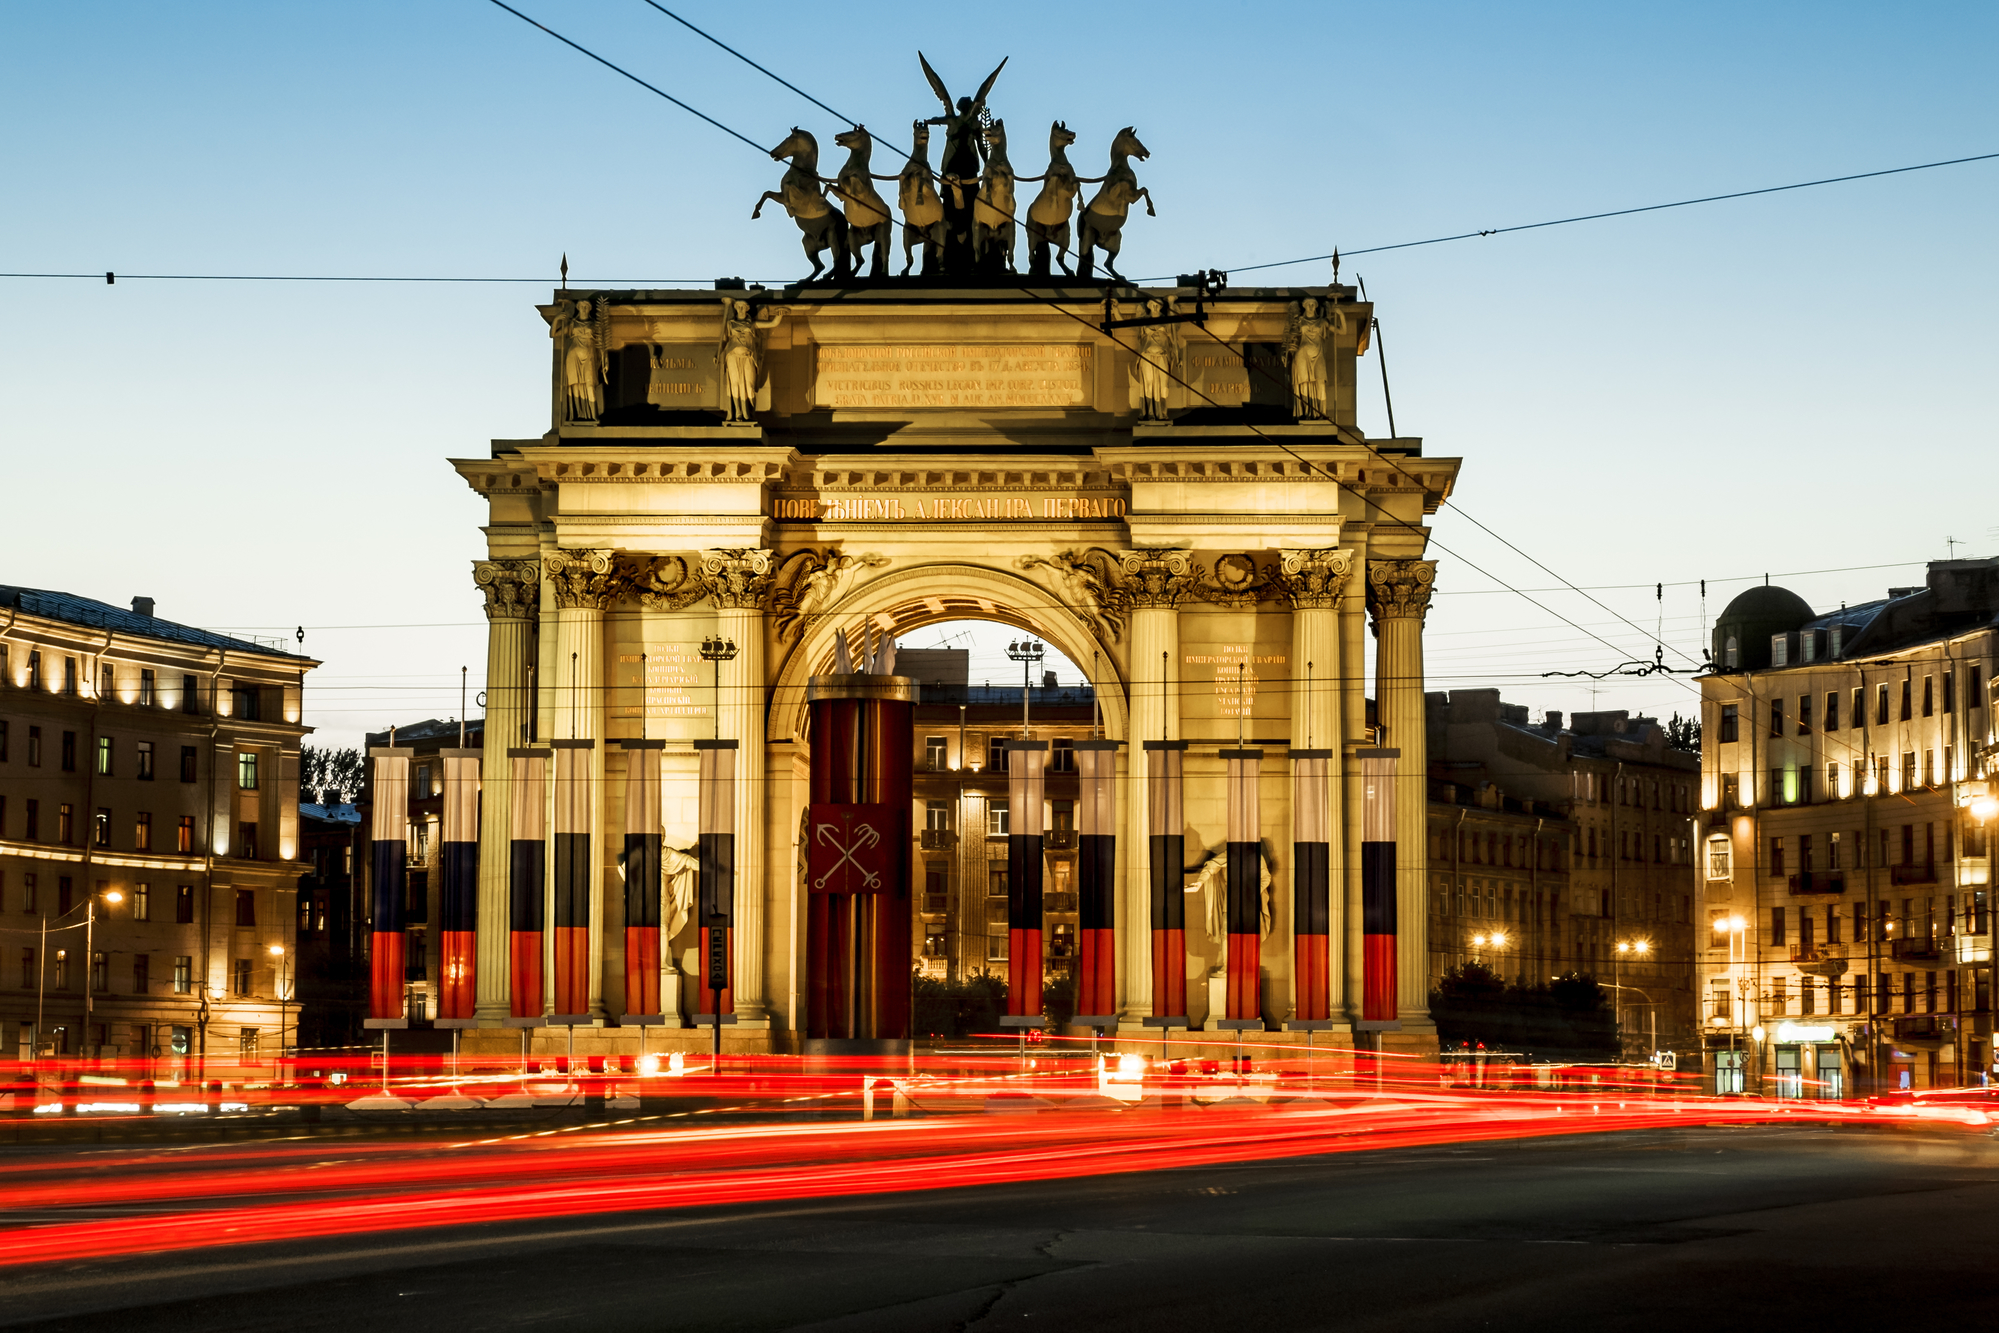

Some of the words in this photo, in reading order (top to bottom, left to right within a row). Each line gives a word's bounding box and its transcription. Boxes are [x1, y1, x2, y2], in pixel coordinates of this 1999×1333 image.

[774, 496, 906, 519] ПОВЕЛѢНІЕМЪ
[912, 498, 1034, 520] АЛЕКСАНДРА
[1043, 497, 1127, 519] ПЕРВАГО
[1223, 645, 1248, 653] ПОЛКИ
[712, 929, 723, 979] ПЕРЕХОД
